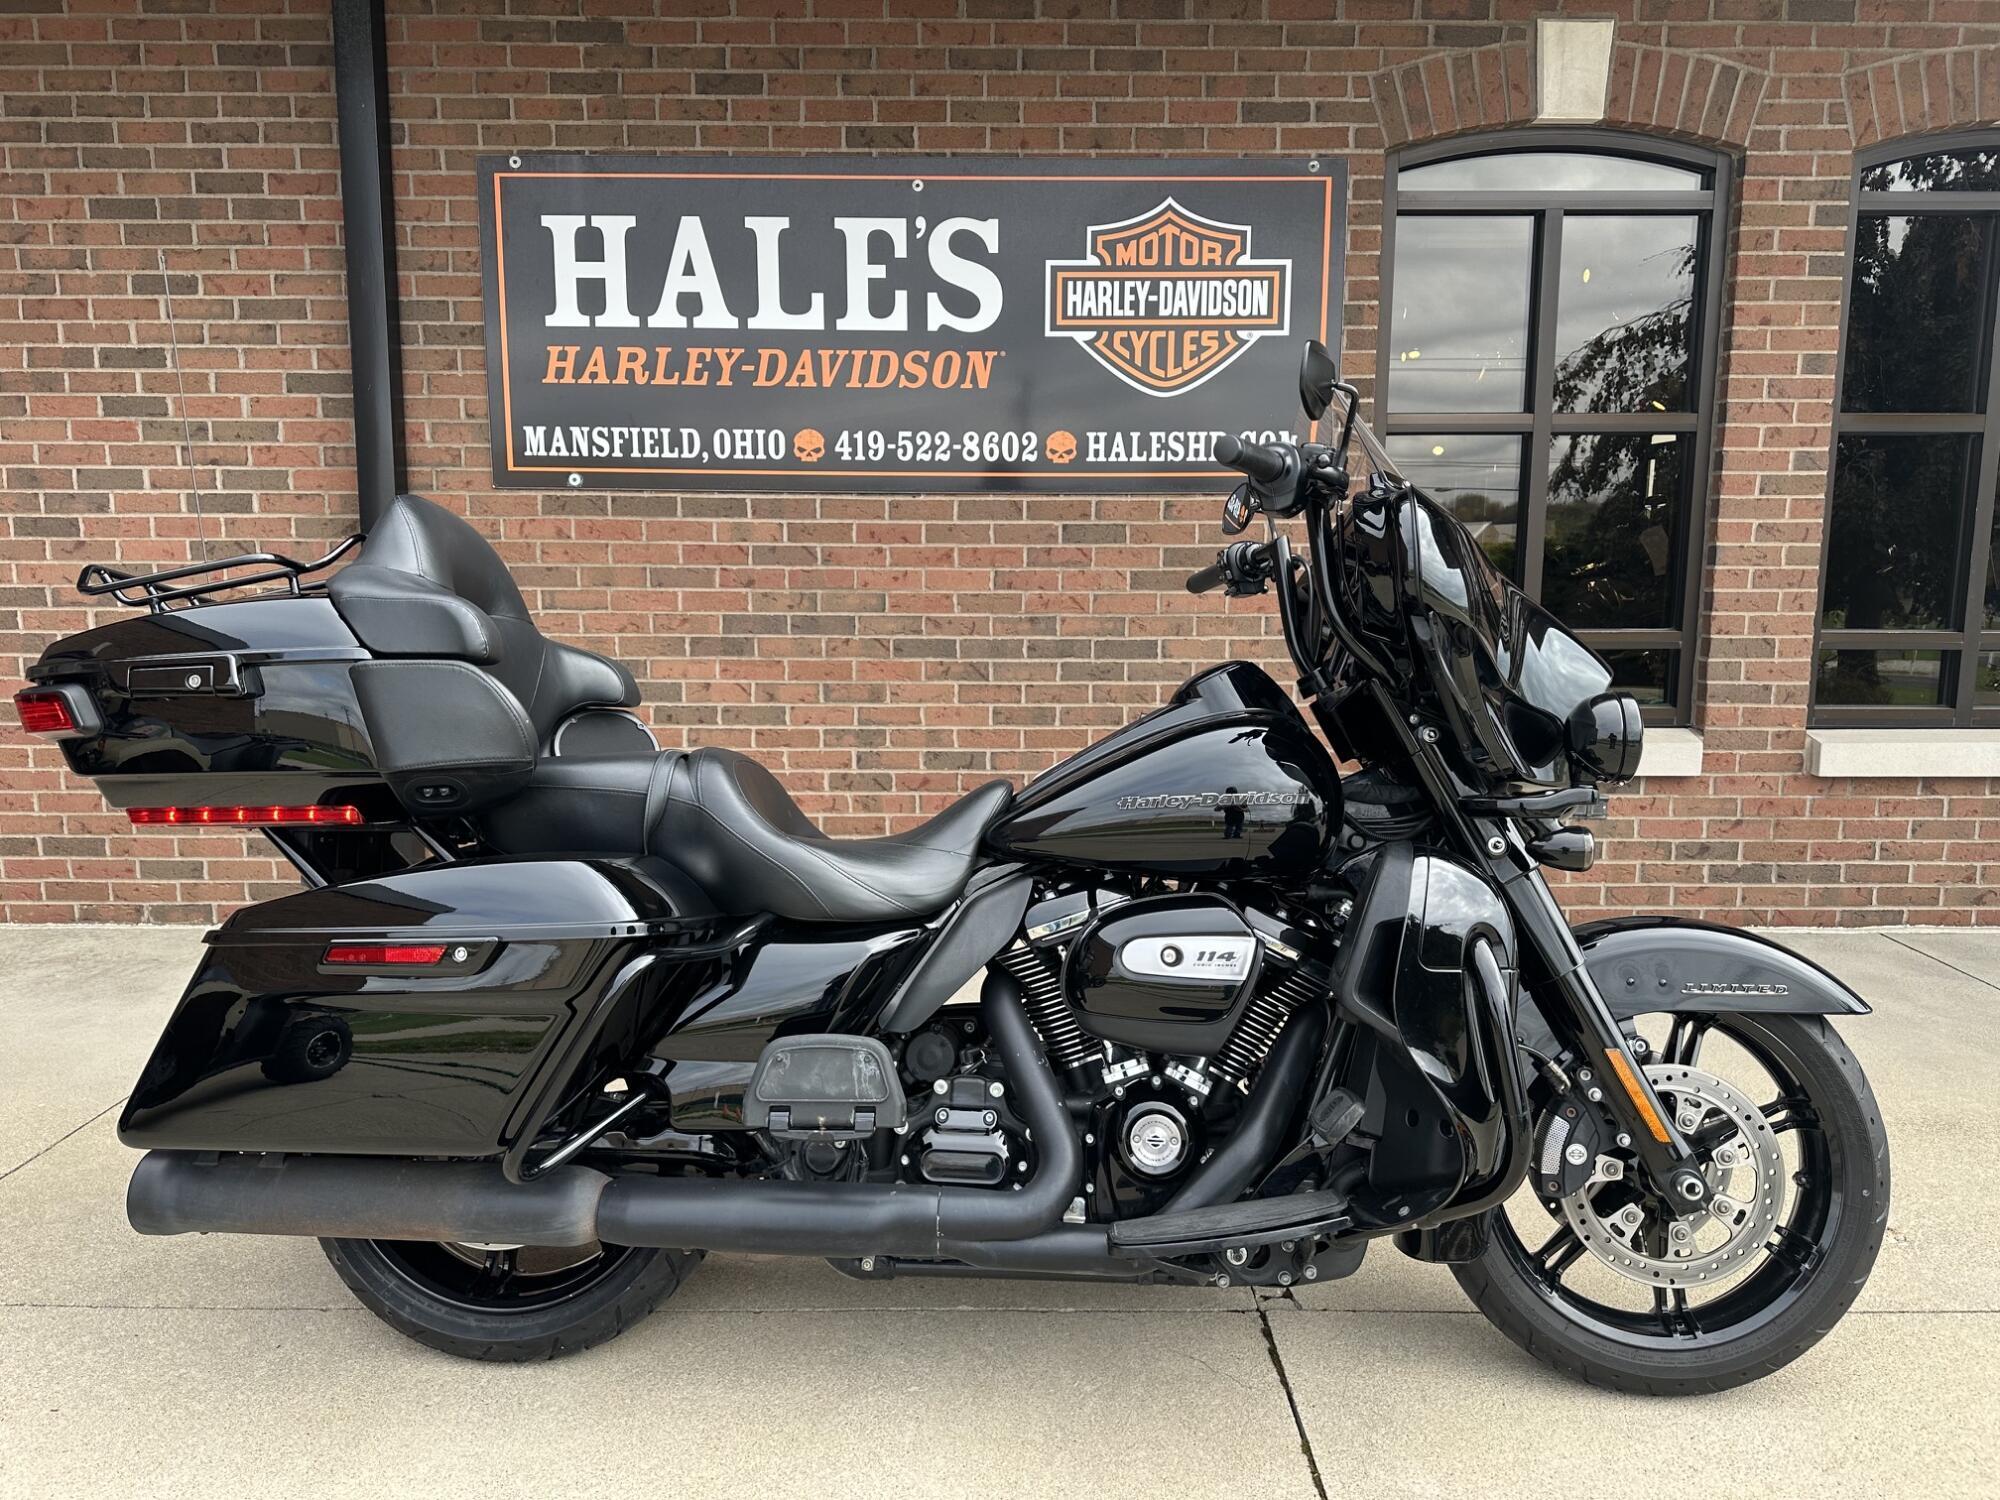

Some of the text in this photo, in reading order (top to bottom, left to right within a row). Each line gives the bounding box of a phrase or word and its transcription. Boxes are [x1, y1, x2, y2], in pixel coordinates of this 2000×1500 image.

[1115, 222, 1223, 267] MOTOR
[540, 213, 1004, 333] HALE'S
[1066, 278, 1270, 317] HARLEY-DAVIDSON
[541, 344, 1000, 389] HARLEY-DAVIDSON
[1112, 329, 1220, 379] CYCLES
[712, 427, 787, 462] OHIO
[834, 429, 1039, 463] 419-522-8602
[1085, 430, 1298, 463] HALESH
[1116, 791, 1311, 811] Harley-Davidson
[1196, 951, 1237, 962] 114
[1682, 982, 1789, 994] LIMITED
